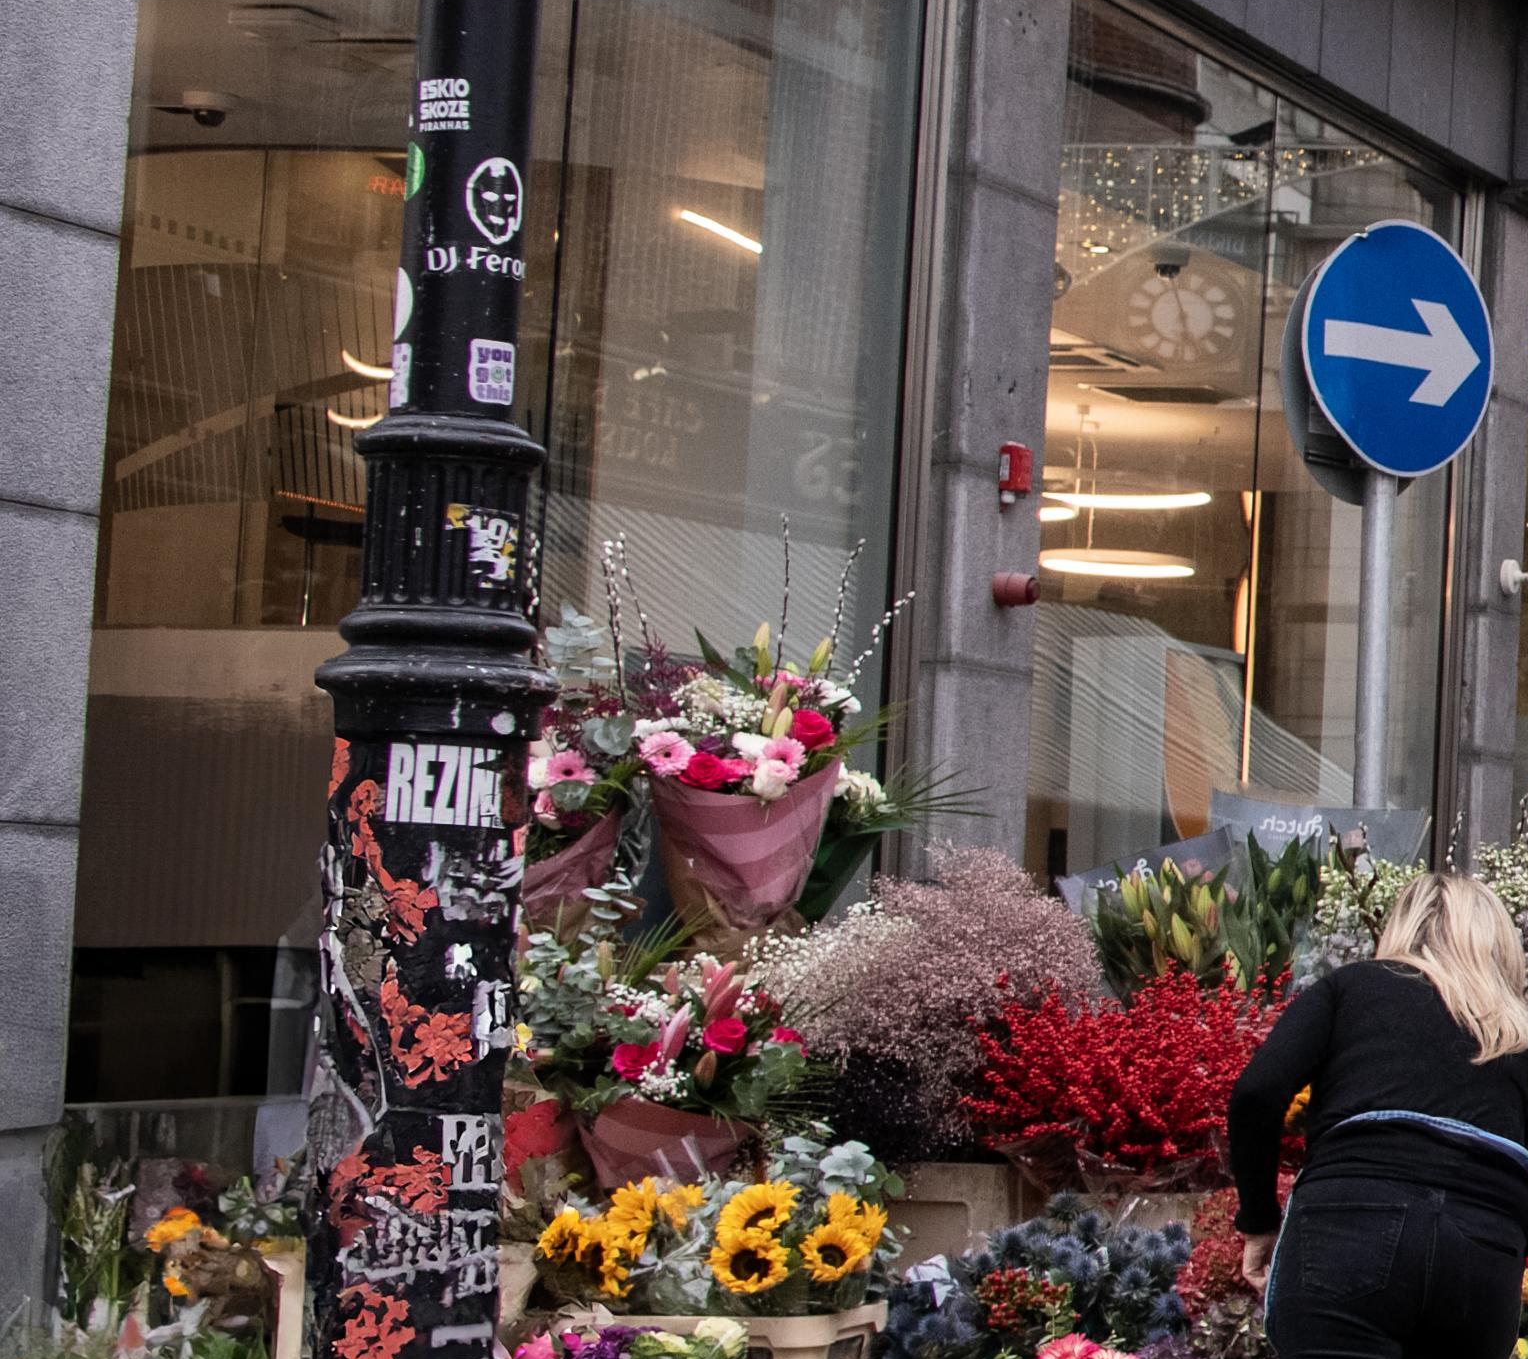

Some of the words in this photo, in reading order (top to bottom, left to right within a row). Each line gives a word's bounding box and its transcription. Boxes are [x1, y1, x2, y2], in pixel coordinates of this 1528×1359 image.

[419, 78, 470, 100] ESKIO
[419, 100, 470, 121] SKOZE
[419, 121, 470, 132] PIRANHAS
[426, 247, 458, 273] DJ
[475, 346, 513, 365] you
[475, 384, 513, 403] this
